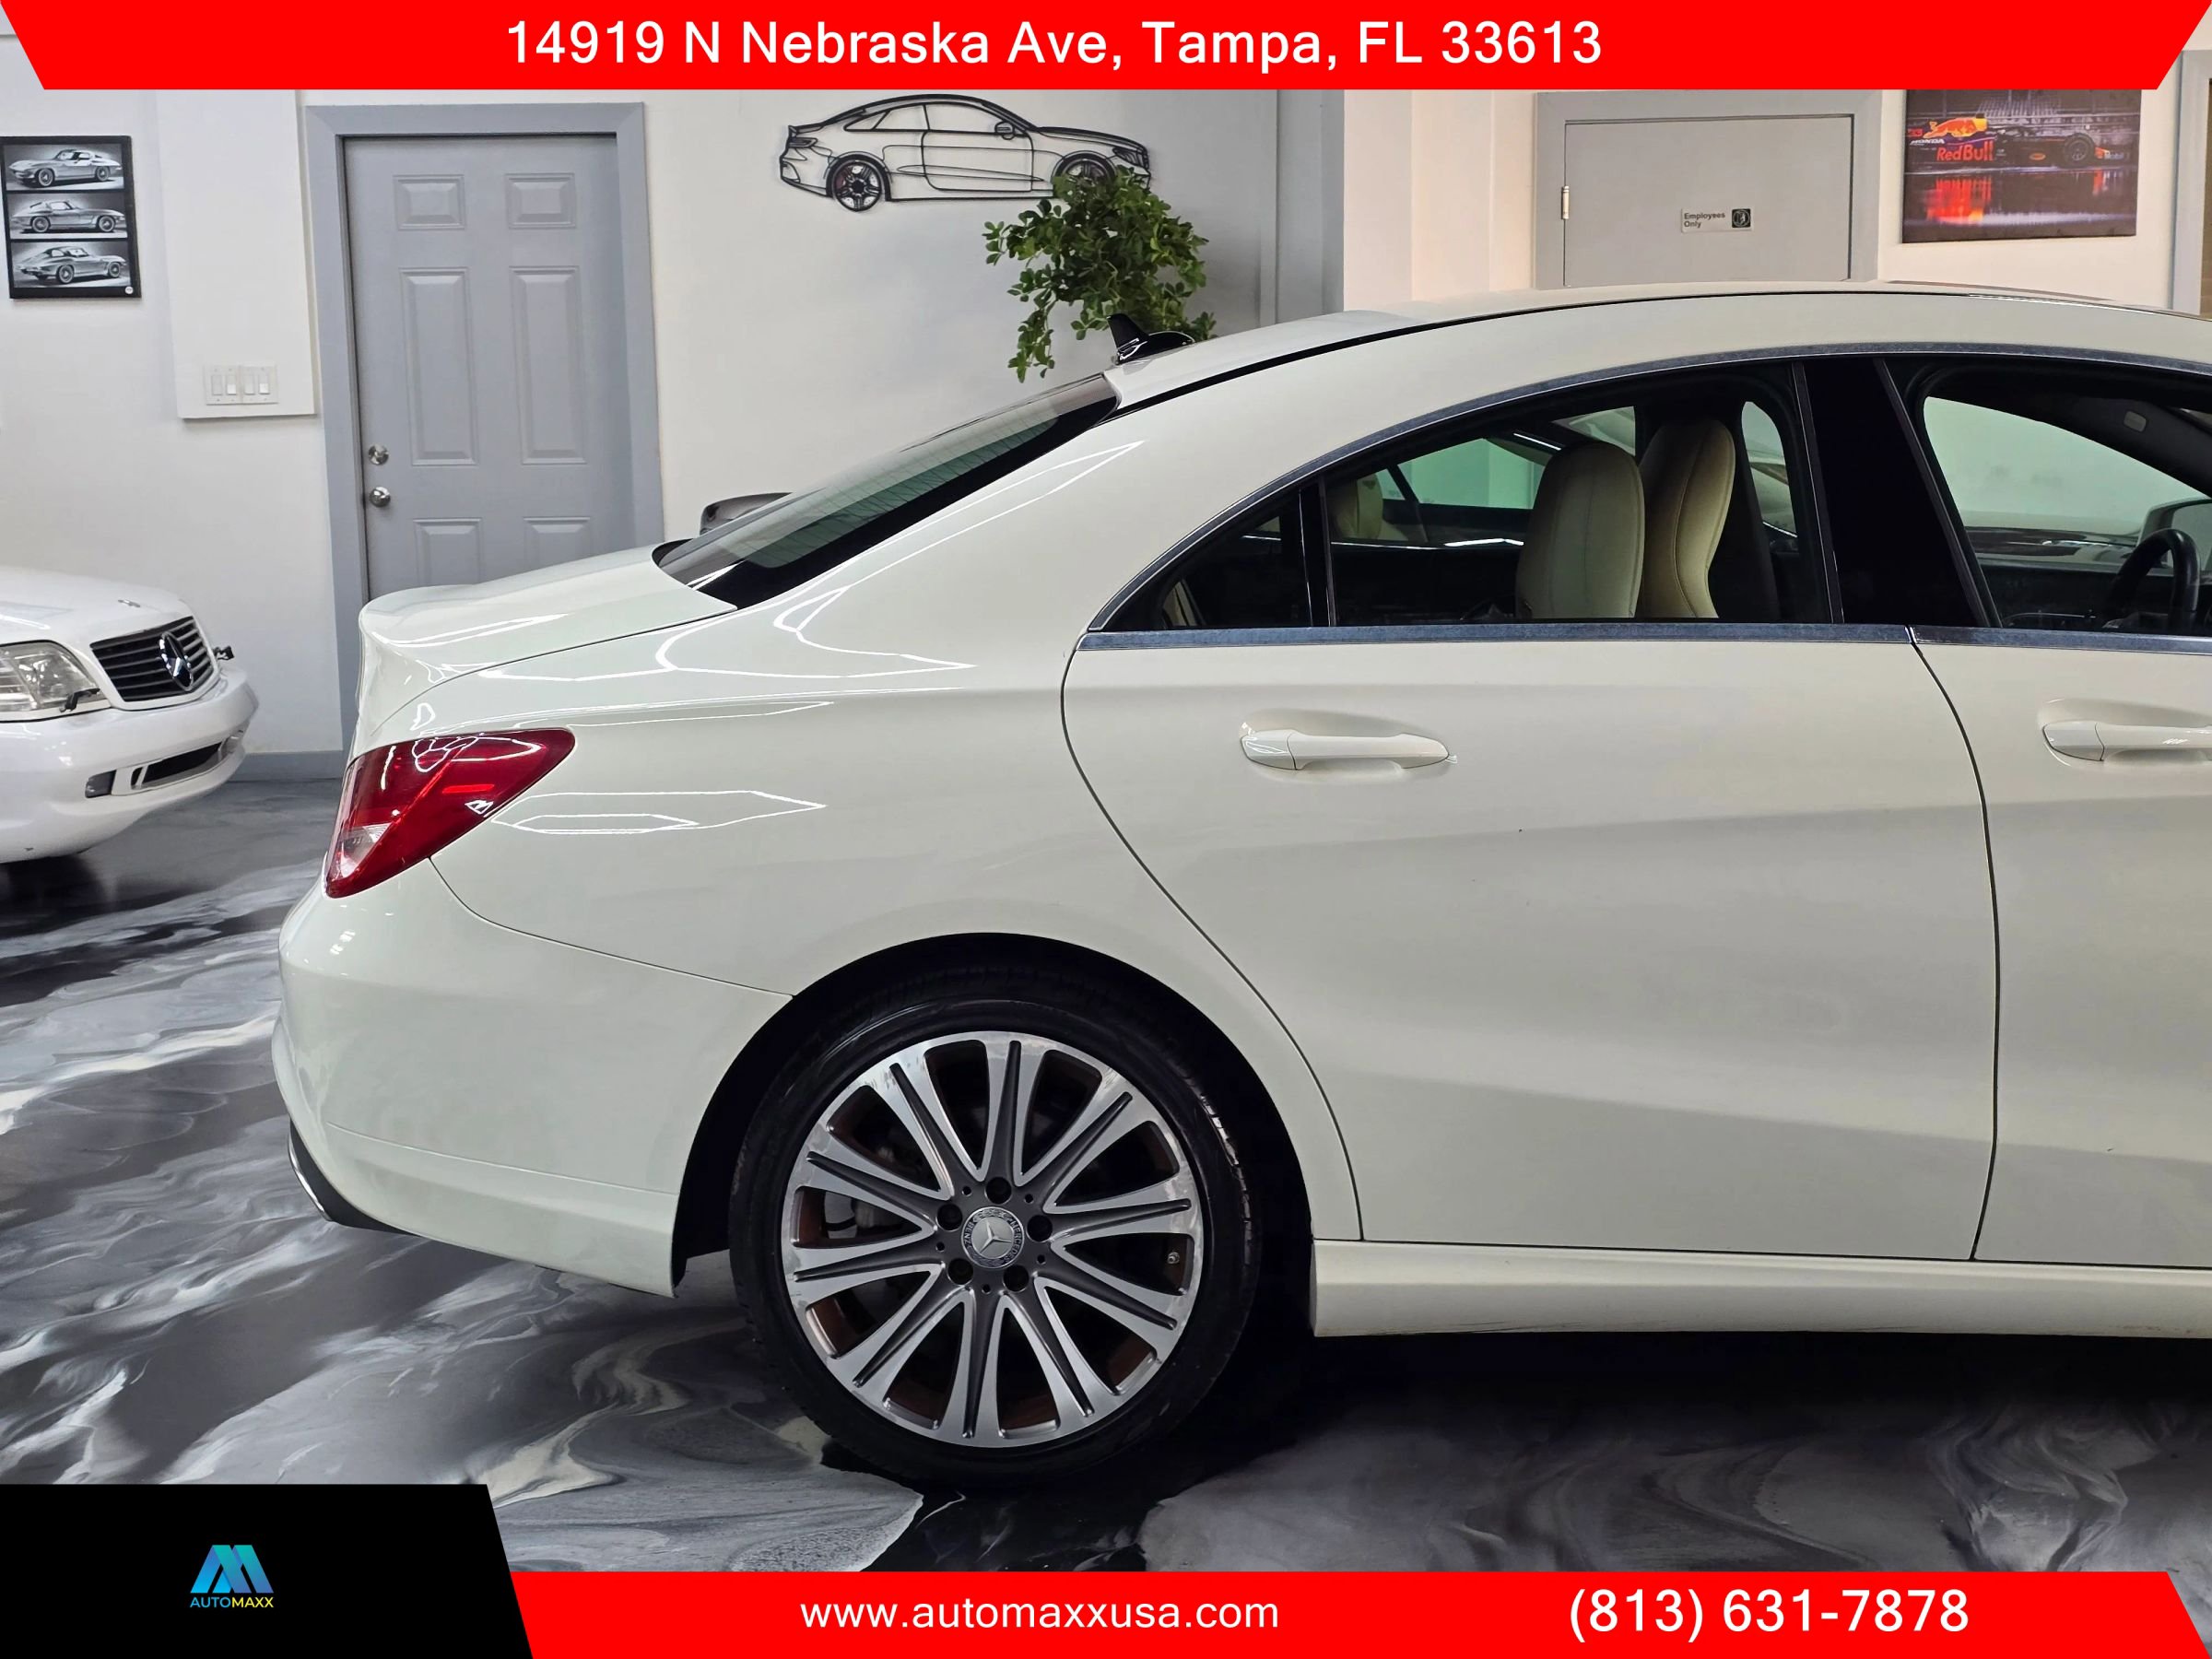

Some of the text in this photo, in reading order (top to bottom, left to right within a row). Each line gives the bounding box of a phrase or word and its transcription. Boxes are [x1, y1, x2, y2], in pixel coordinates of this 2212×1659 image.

[1684, 212, 1725, 220] Employees
[1684, 220, 1701, 229] Only
[964, 1222, 975, 1247] BENZ
